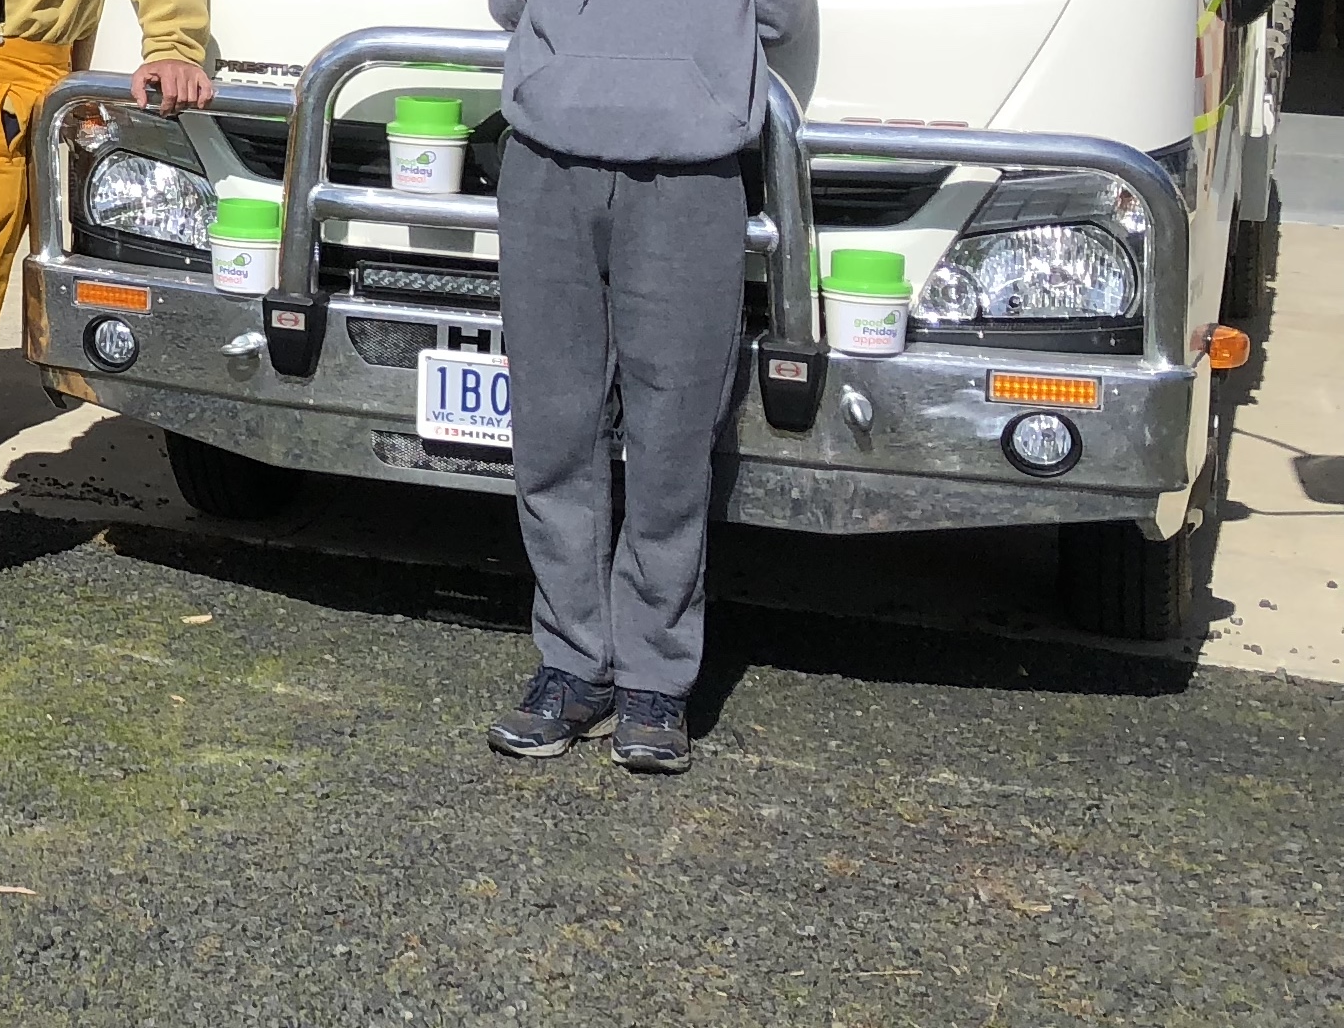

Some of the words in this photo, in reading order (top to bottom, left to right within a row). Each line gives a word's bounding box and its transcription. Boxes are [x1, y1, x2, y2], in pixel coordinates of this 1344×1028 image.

[214, 58, 306, 77] PRESTIG
[432, 410, 455, 422] VIC
[470, 415, 503, 429] STAY
